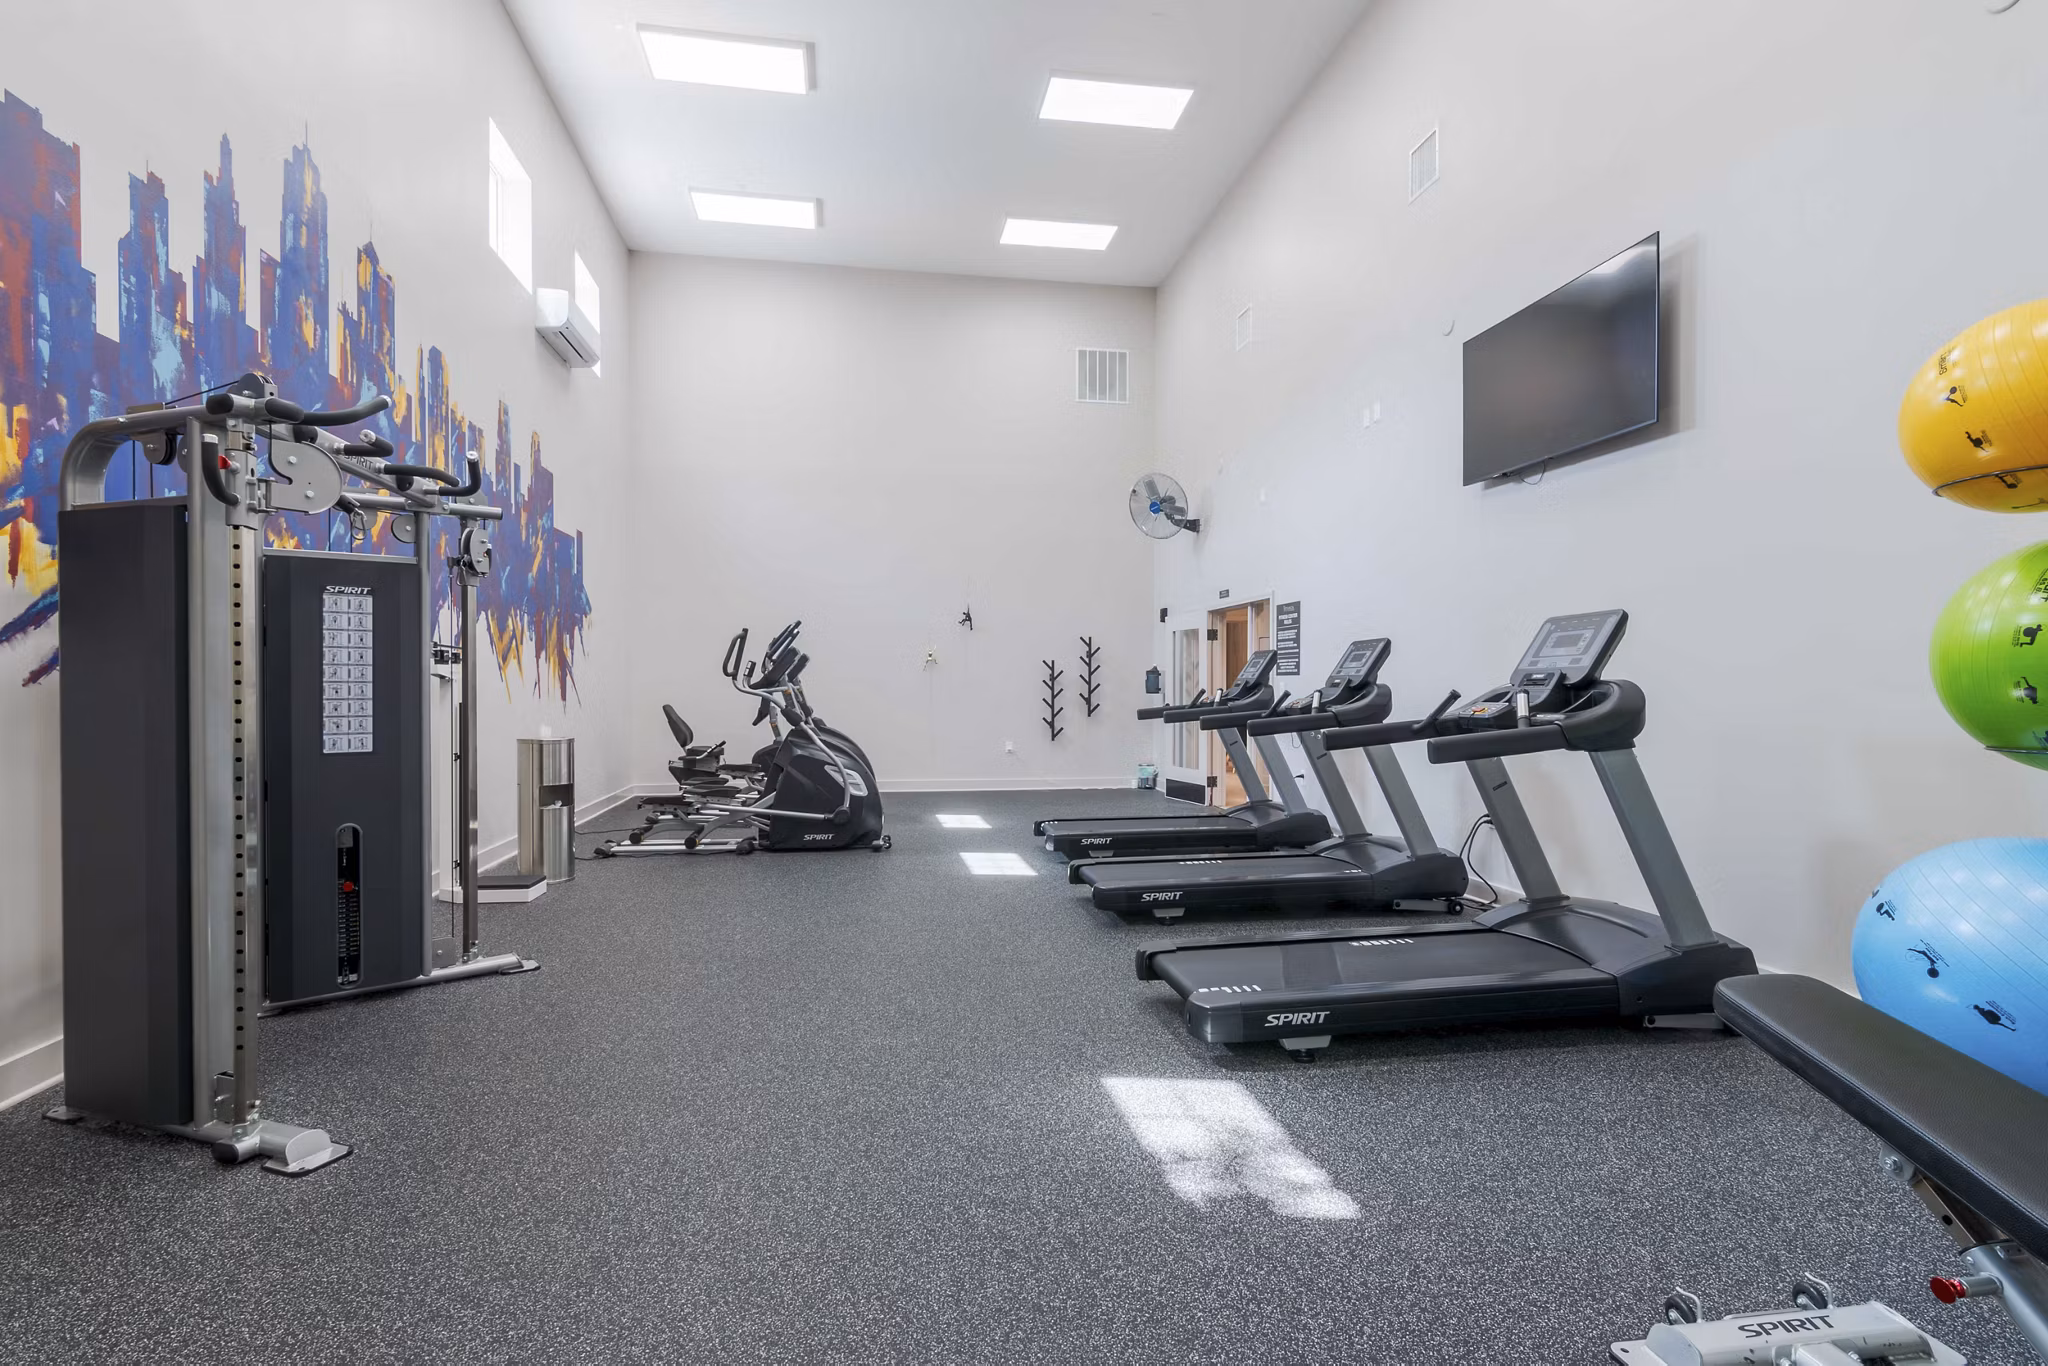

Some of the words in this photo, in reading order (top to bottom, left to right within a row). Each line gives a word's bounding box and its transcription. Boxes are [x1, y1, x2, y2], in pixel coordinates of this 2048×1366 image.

[325, 585, 372, 595] SPIRIT
[803, 833, 835, 841] SPIRIT
[1080, 837, 1113, 845] SPIRIT
[1141, 891, 1183, 902] SPIRIT
[1264, 1011, 1331, 1027] SPIRIT
[1738, 1314, 1835, 1339] SPIRIT
